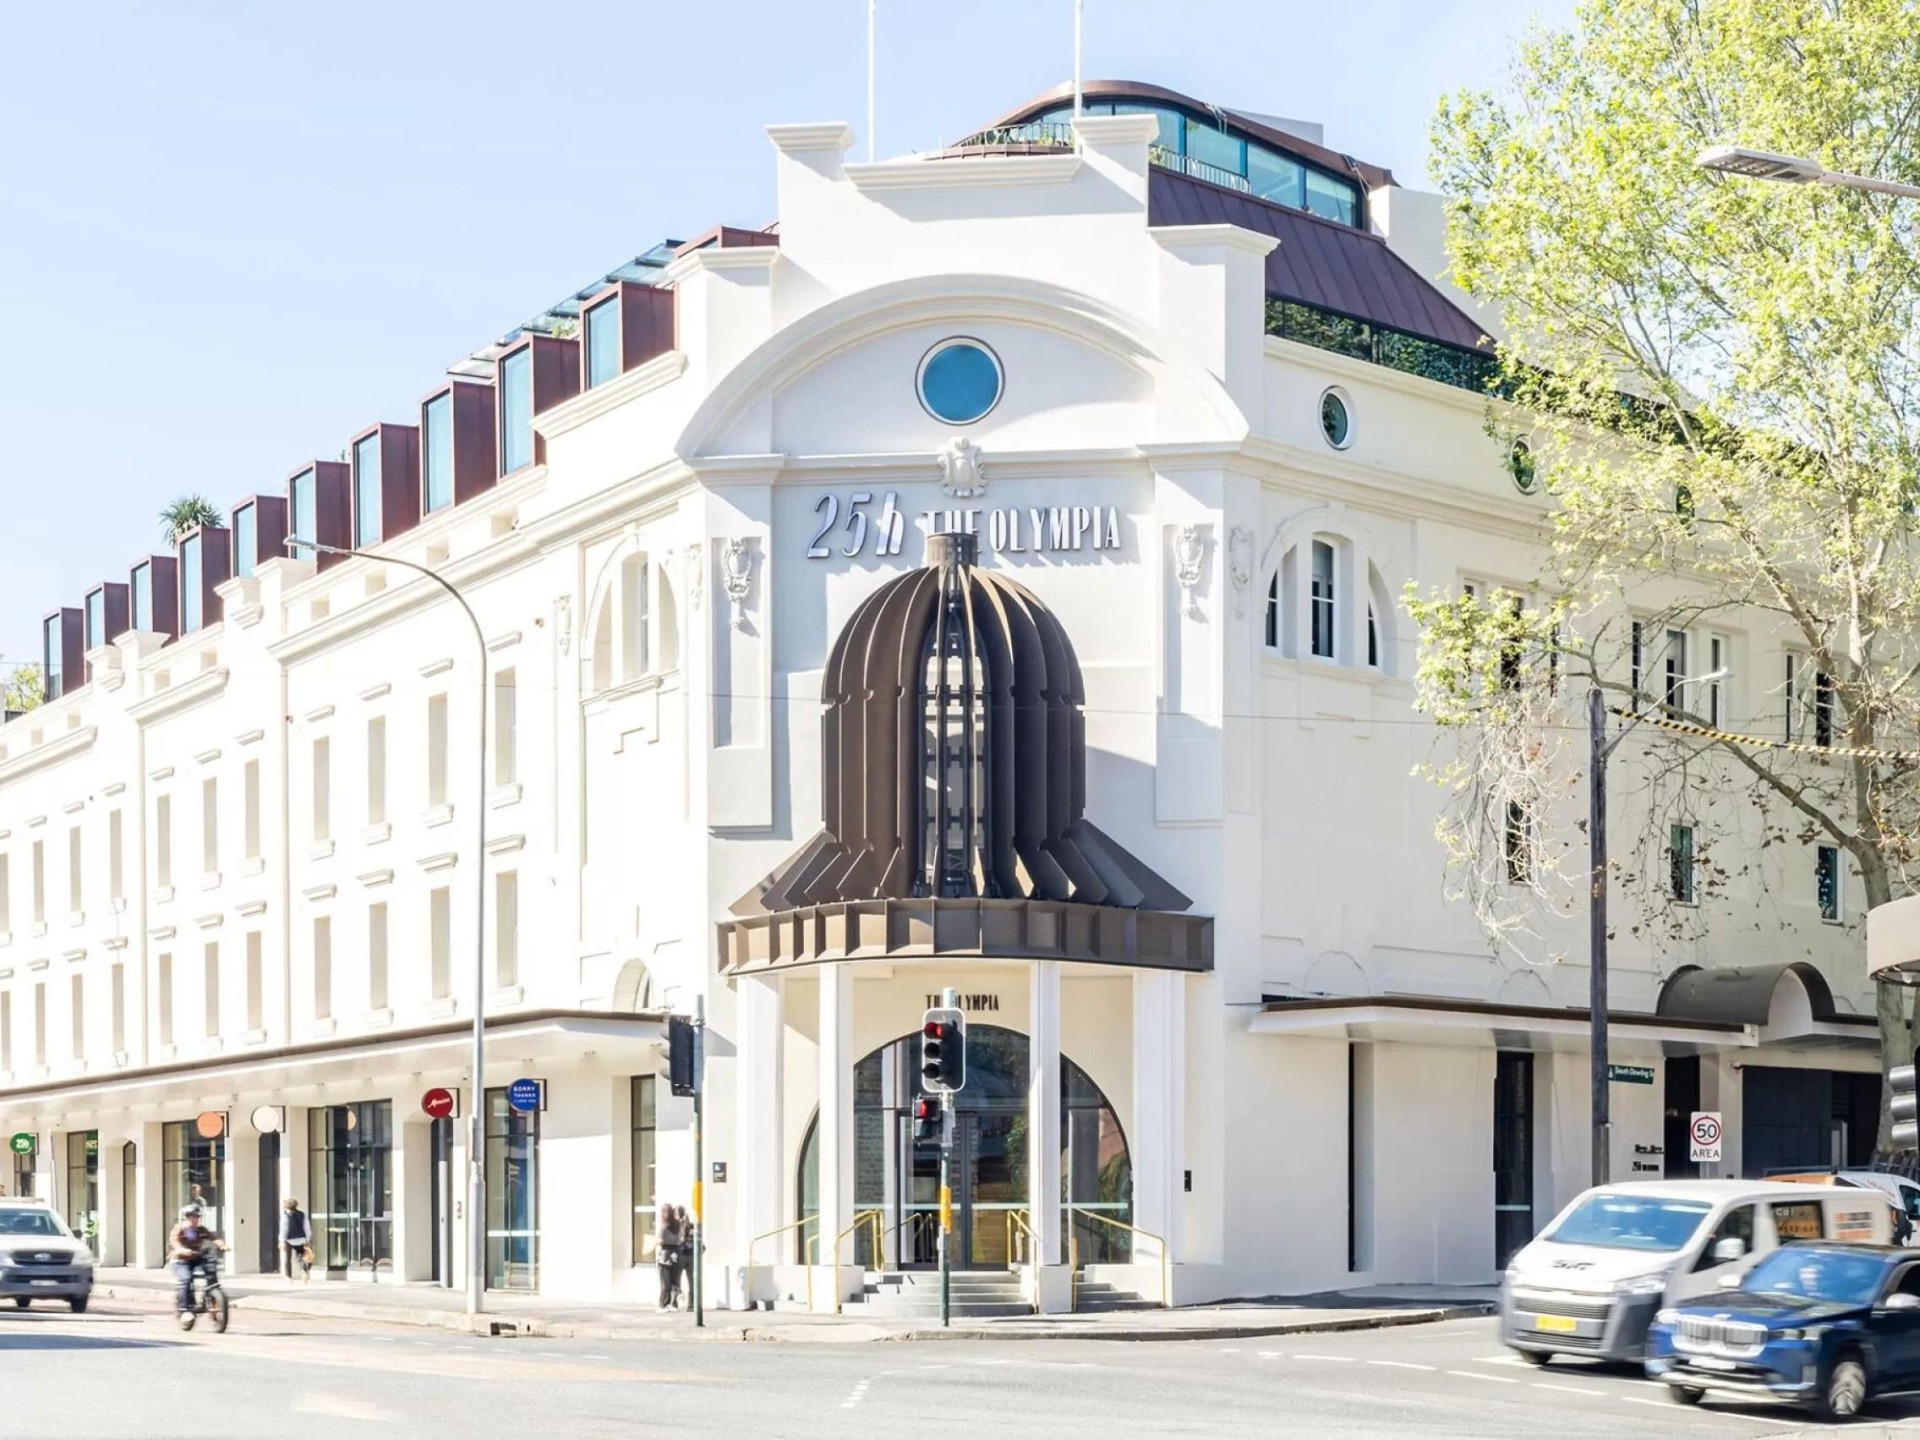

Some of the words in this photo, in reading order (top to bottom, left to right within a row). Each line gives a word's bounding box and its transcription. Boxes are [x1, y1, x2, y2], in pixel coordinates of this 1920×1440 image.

[806, 491, 905, 559] 25h
[988, 504, 1121, 554] OLYMPIA
[1696, 1123, 1718, 1139] 50
[1691, 1148, 1720, 1158] AREA
